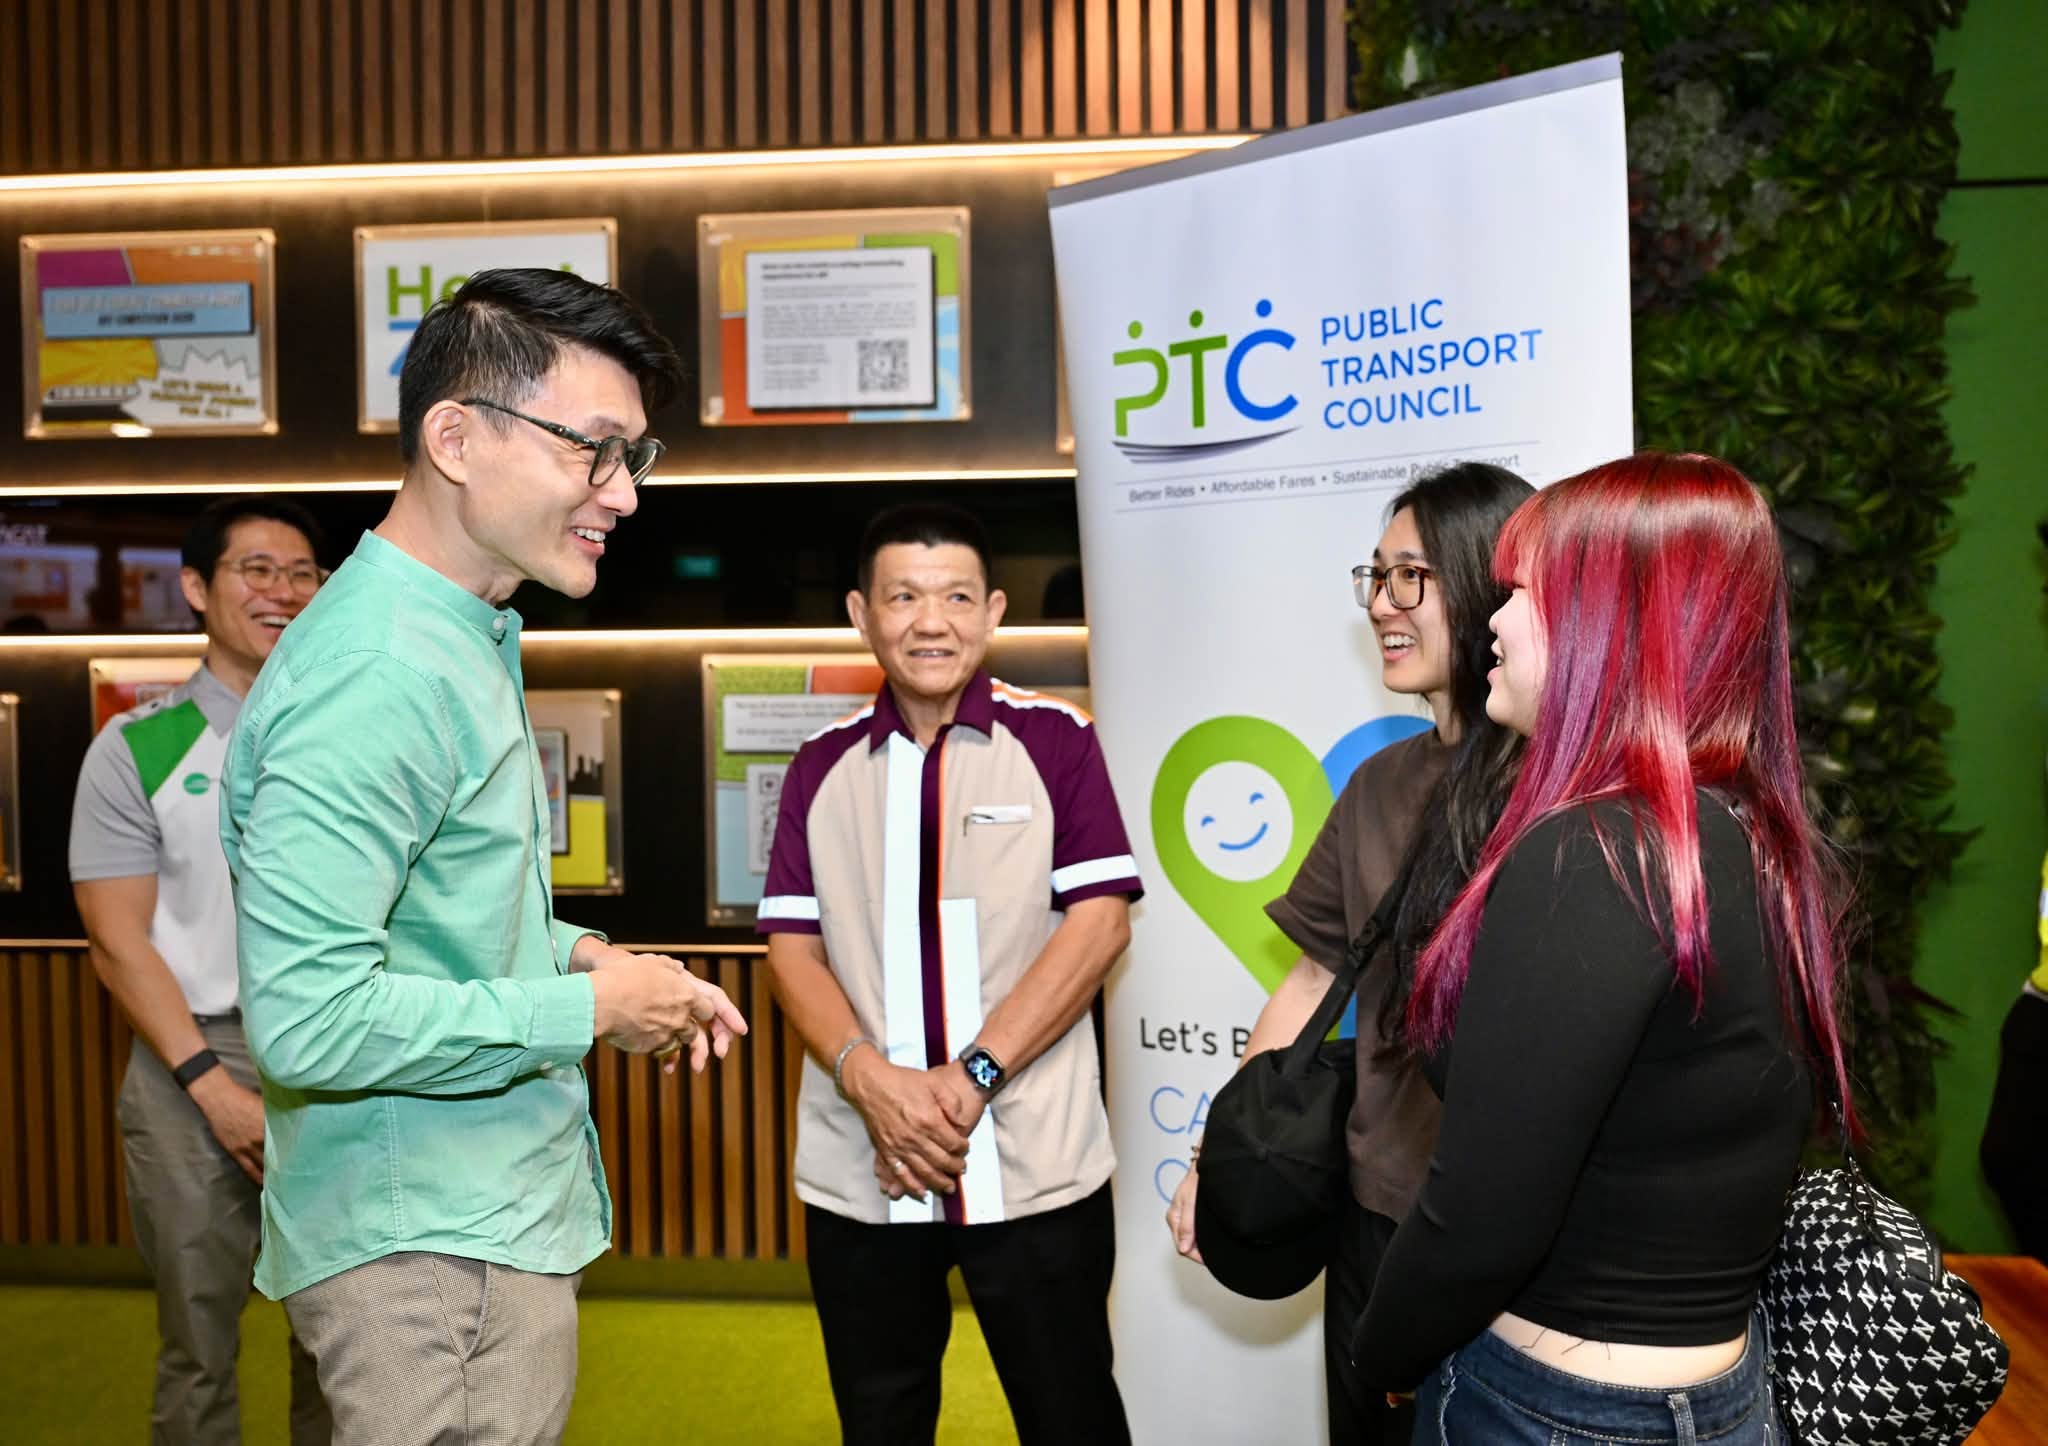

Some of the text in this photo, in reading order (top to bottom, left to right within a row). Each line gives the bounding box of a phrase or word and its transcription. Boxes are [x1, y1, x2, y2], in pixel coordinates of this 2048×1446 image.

[1321, 299, 1443, 346] PUBLIC
[1321, 329, 1543, 388] TRANSPORT
[1112, 326, 1299, 438] PTC
[1323, 384, 1482, 430] COUNCIL
[1129, 489, 1162, 504] Better
[1165, 486, 1196, 499] Rides
[1211, 478, 1276, 494] Affordable
[1279, 474, 1315, 489] Fares
[1333, 464, 1407, 485] Sustainable
[1140, 1017, 1217, 1055] Let's
